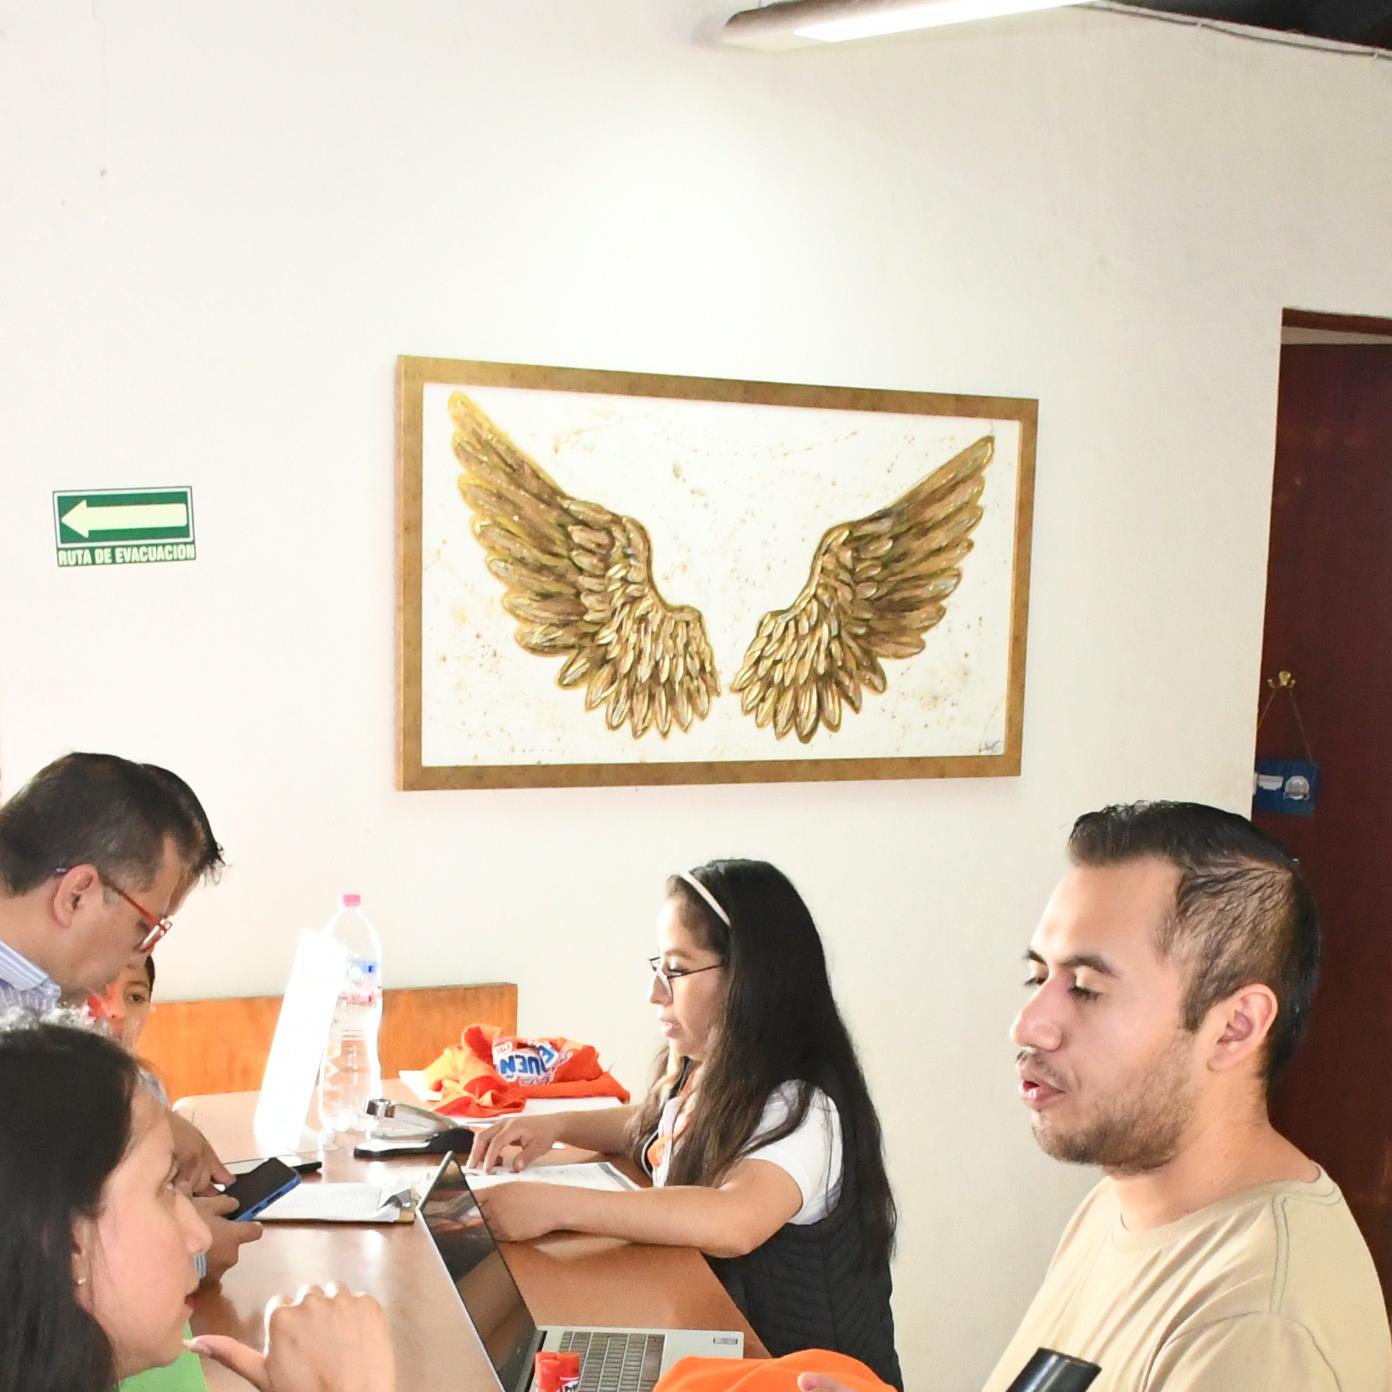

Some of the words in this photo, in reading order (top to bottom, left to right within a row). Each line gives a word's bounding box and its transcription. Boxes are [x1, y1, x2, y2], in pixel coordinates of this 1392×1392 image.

[59, 549, 91, 565] RUTA
[95, 548, 112, 564] DE
[115, 544, 196, 563] EVACUACION
